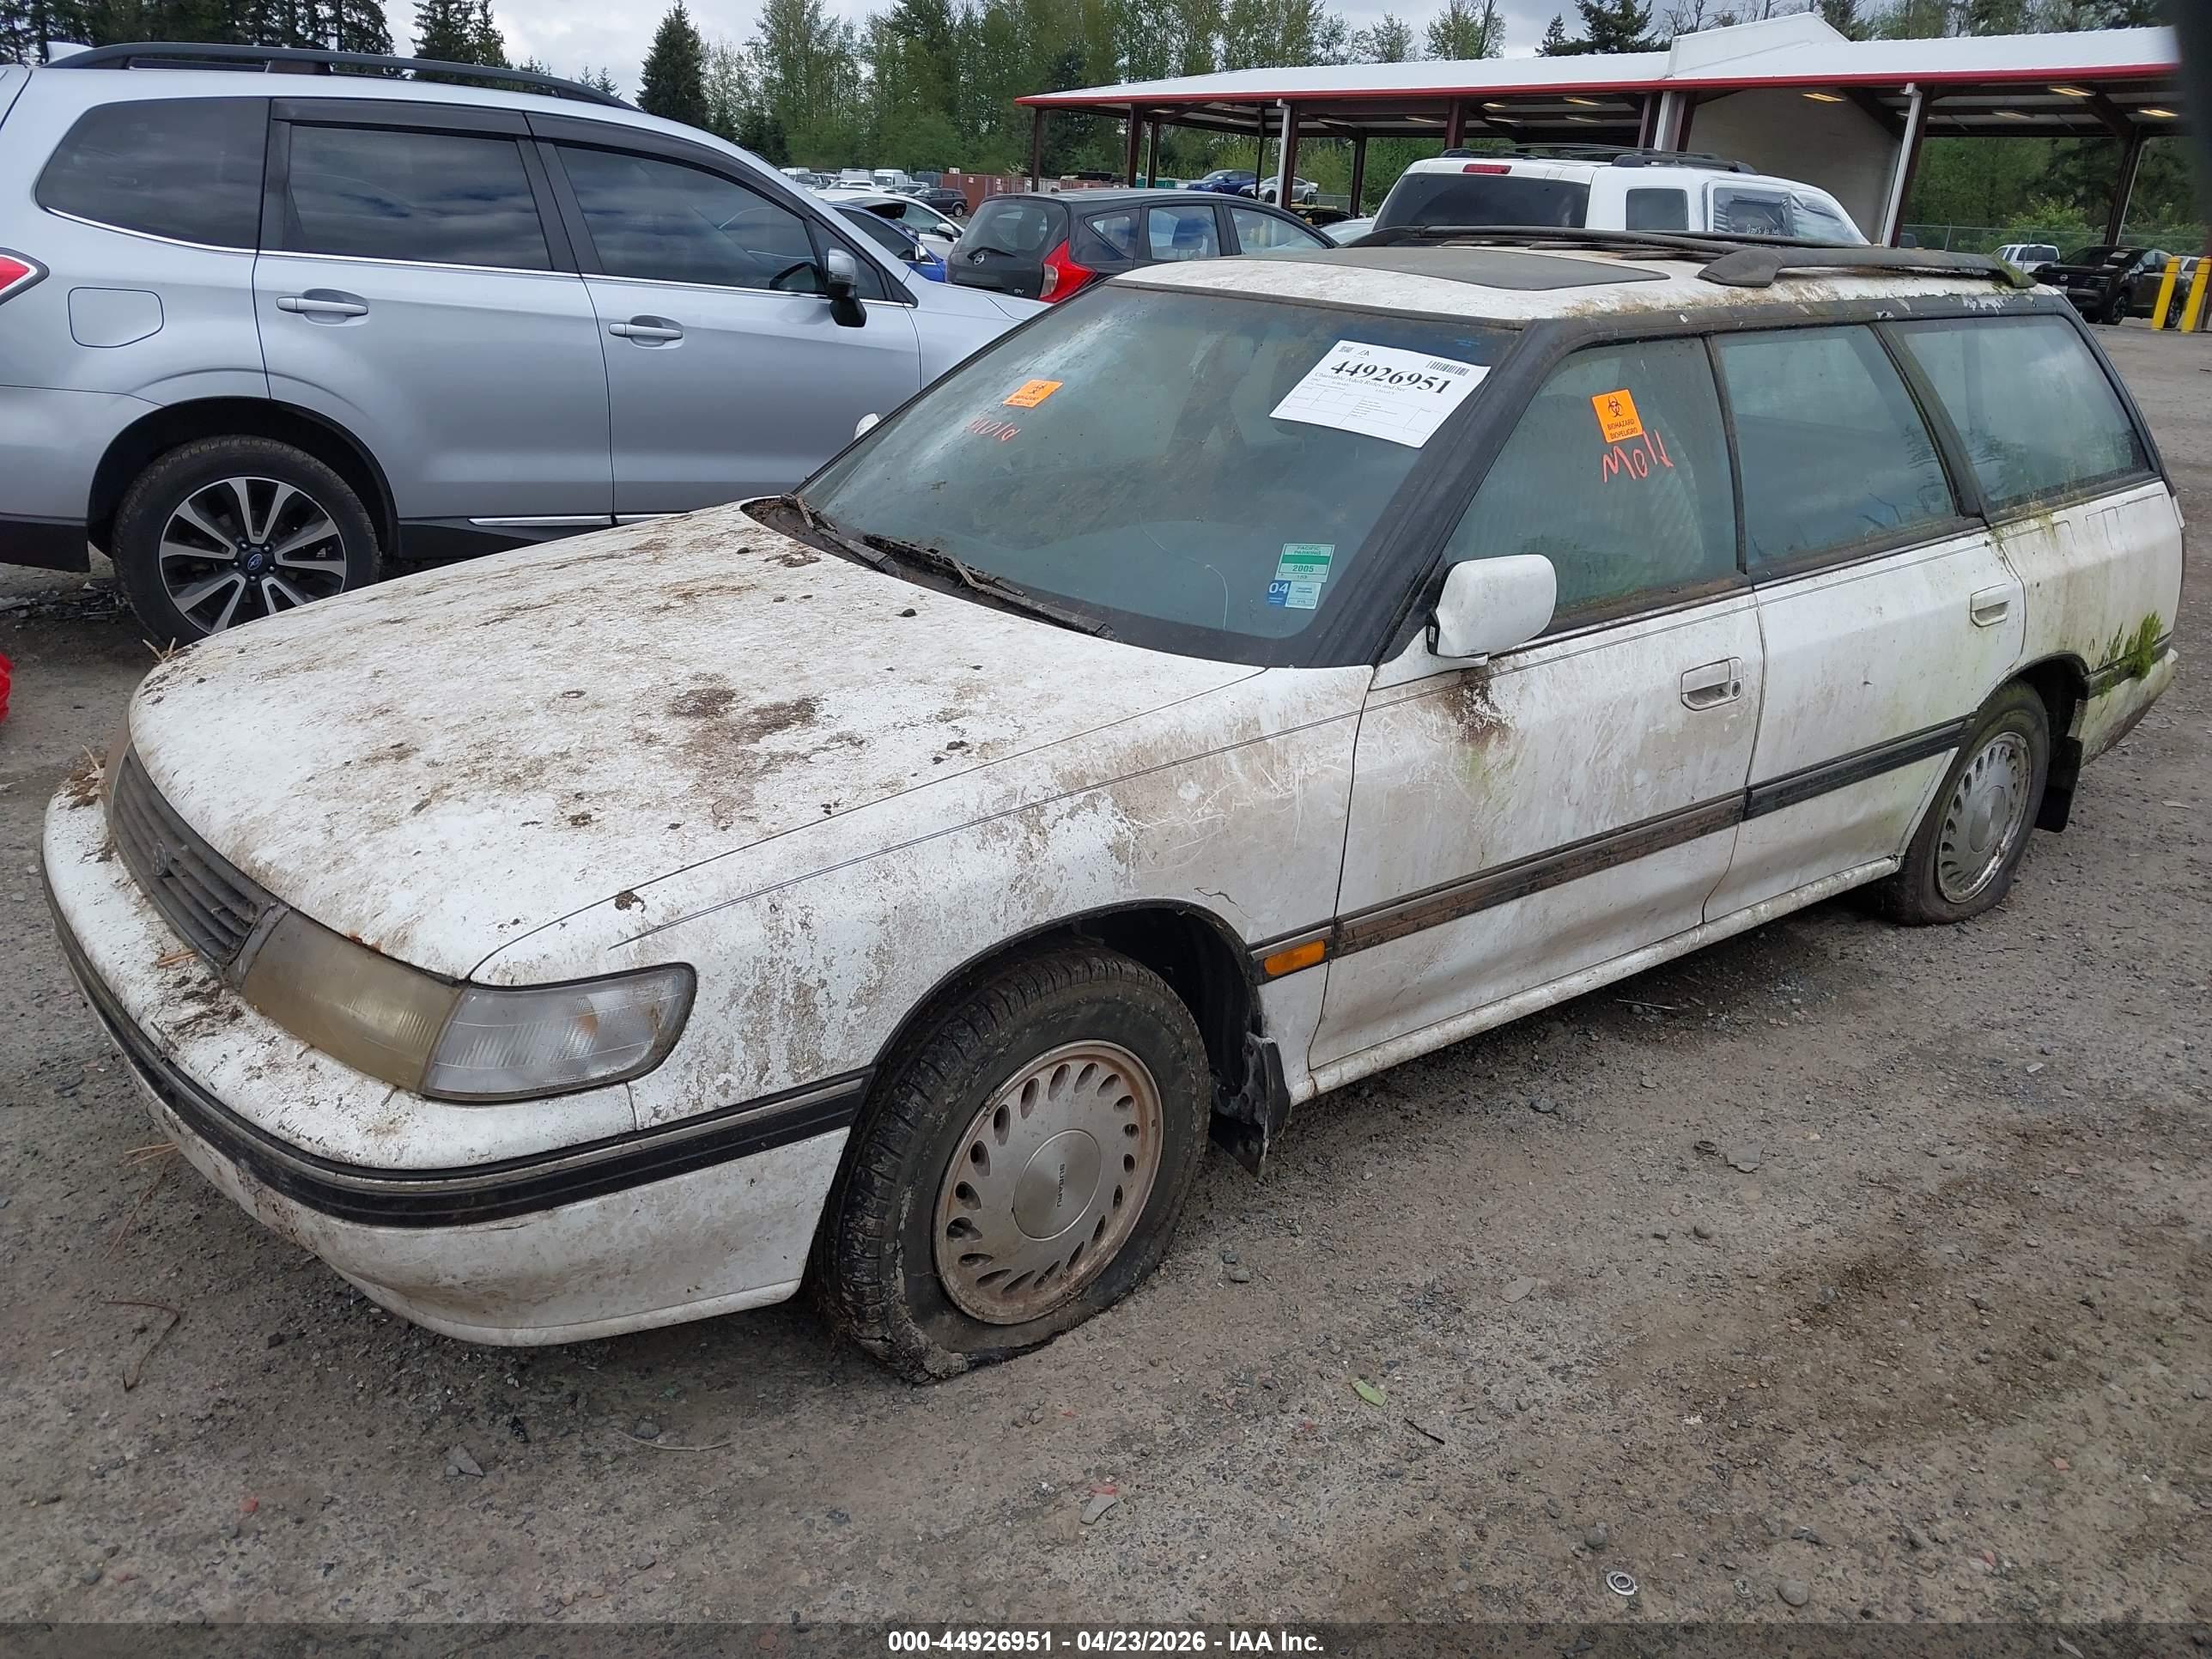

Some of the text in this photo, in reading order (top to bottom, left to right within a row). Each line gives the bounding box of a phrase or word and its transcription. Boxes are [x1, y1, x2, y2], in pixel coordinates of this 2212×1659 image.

[1330, 360, 1452, 395] 44926951
[1607, 418, 1635, 431] BIOHAZARD
[1291, 564, 1315, 573] 2005
[1268, 582, 1289, 594] 04
[1056, 1164, 1066, 1208] SUBARU
